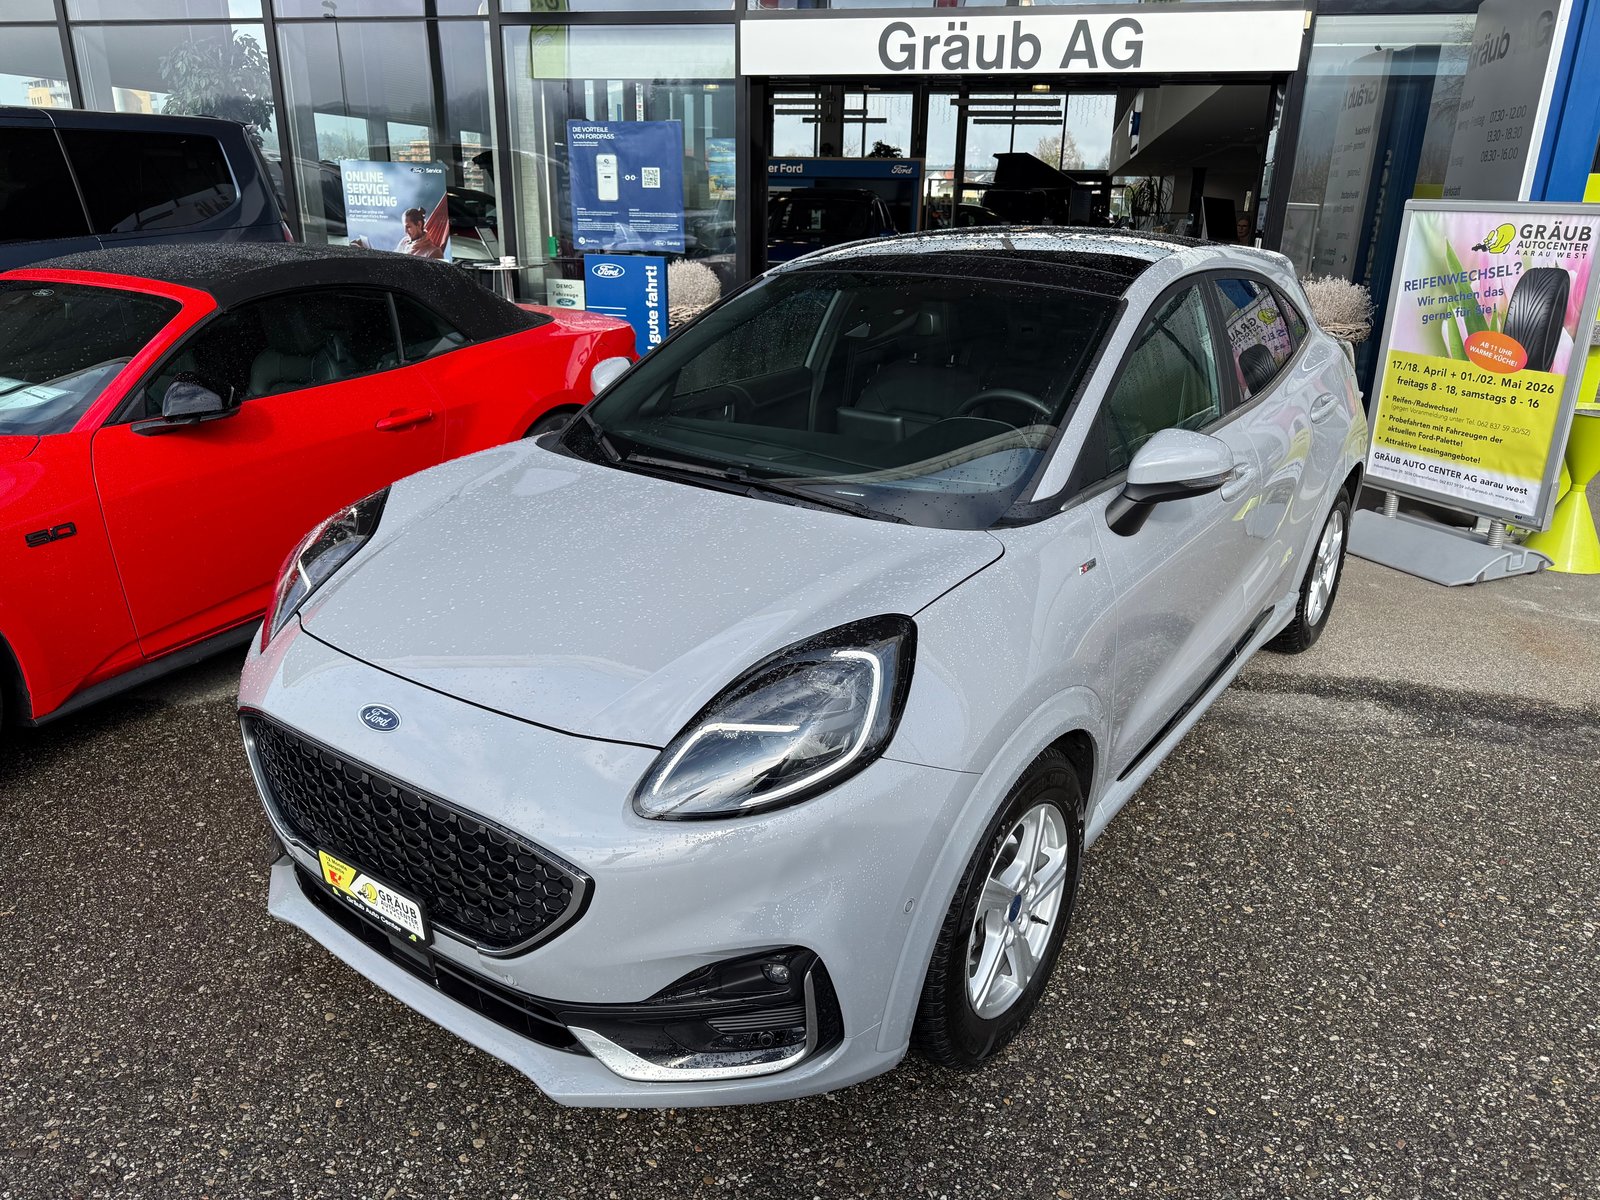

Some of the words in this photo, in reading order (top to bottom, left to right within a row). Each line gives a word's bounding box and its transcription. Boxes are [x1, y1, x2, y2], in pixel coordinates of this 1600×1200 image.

[878, 20, 1041, 71] Gräub
[1059, 18, 1143, 70] AG
[344, 171, 384, 183] ONLINE
[780, 163, 803, 173] Ford
[891, 165, 913, 174] Ford
[346, 183, 390, 195] SERVICE
[347, 194, 398, 208] BUCHUNG
[1519, 220, 1592, 242] GRÄUB
[1514, 250, 1551, 258] AARAU
[1556, 251, 1587, 260] WEST
[1517, 240, 1589, 252] AUTOCENTER
[597, 264, 620, 276] Ford
[1404, 261, 1523, 292] REIFENWECHSEL?
[552, 290, 579, 298] Fahrzeuge
[645, 265, 659, 307] fahrt!
[1417, 296, 1435, 307] Wir
[1438, 290, 1480, 304] machen
[1483, 285, 1504, 297] das
[1421, 310, 1452, 325] gerne
[1455, 307, 1471, 318] für
[1475, 303, 1497, 315] Sie!
[647, 310, 661, 344] gute
[1469, 345, 1493, 359] WARME
[1493, 352, 1518, 367] KÜCHE!
[1499, 348, 1513, 356] UHR
[1392, 360, 1420, 373] 17./18.
[1423, 366, 1447, 378] April
[1460, 371, 1497, 386] 01./02.
[1501, 377, 1522, 390] Mai
[1525, 381, 1555, 394] 2026
[1397, 375, 1429, 391] freitags
[1430, 382, 1437, 391] 8
[1445, 385, 1458, 396] 18,
[1461, 389, 1507, 405] samstags
[1509, 395, 1517, 405] 8
[1527, 398, 1540, 409] 16
[1392, 395, 1458, 414] Reifen-/Radwechsel!
[1391, 402, 1409, 414] (gegen
[1409, 406, 1448, 421] Voranmeldung
[1449, 415, 1464, 424] unter
[1476, 419, 1488, 429] 062
[1489, 421, 1501, 430] 837
[1502, 424, 1510, 432] 59
[1387, 425, 1417, 437] aktuellen
[1418, 431, 1463, 447] Ford-Palette!
[1388, 414, 1431, 430] Probefahrten
[1432, 424, 1443, 432] mit
[1445, 426, 1488, 442] Fahrzeugen
[1489, 435, 1504, 444] der
[1384, 437, 1417, 450] Attraktive
[1418, 444, 1481, 464] Leasingangebote!
[1374, 451, 1401, 465] GRÄUB
[1402, 459, 1426, 471] AUTO
[1428, 464, 1462, 479] CENTER
[1463, 473, 1477, 483] AG
[1479, 478, 1504, 489] aarau
[1506, 485, 1528, 496] west
[24, 522, 77, 548] 5.0
[365, 707, 393, 727] Ford
[378, 889, 417, 919] GRÄUB
[380, 916, 402, 932] Center
